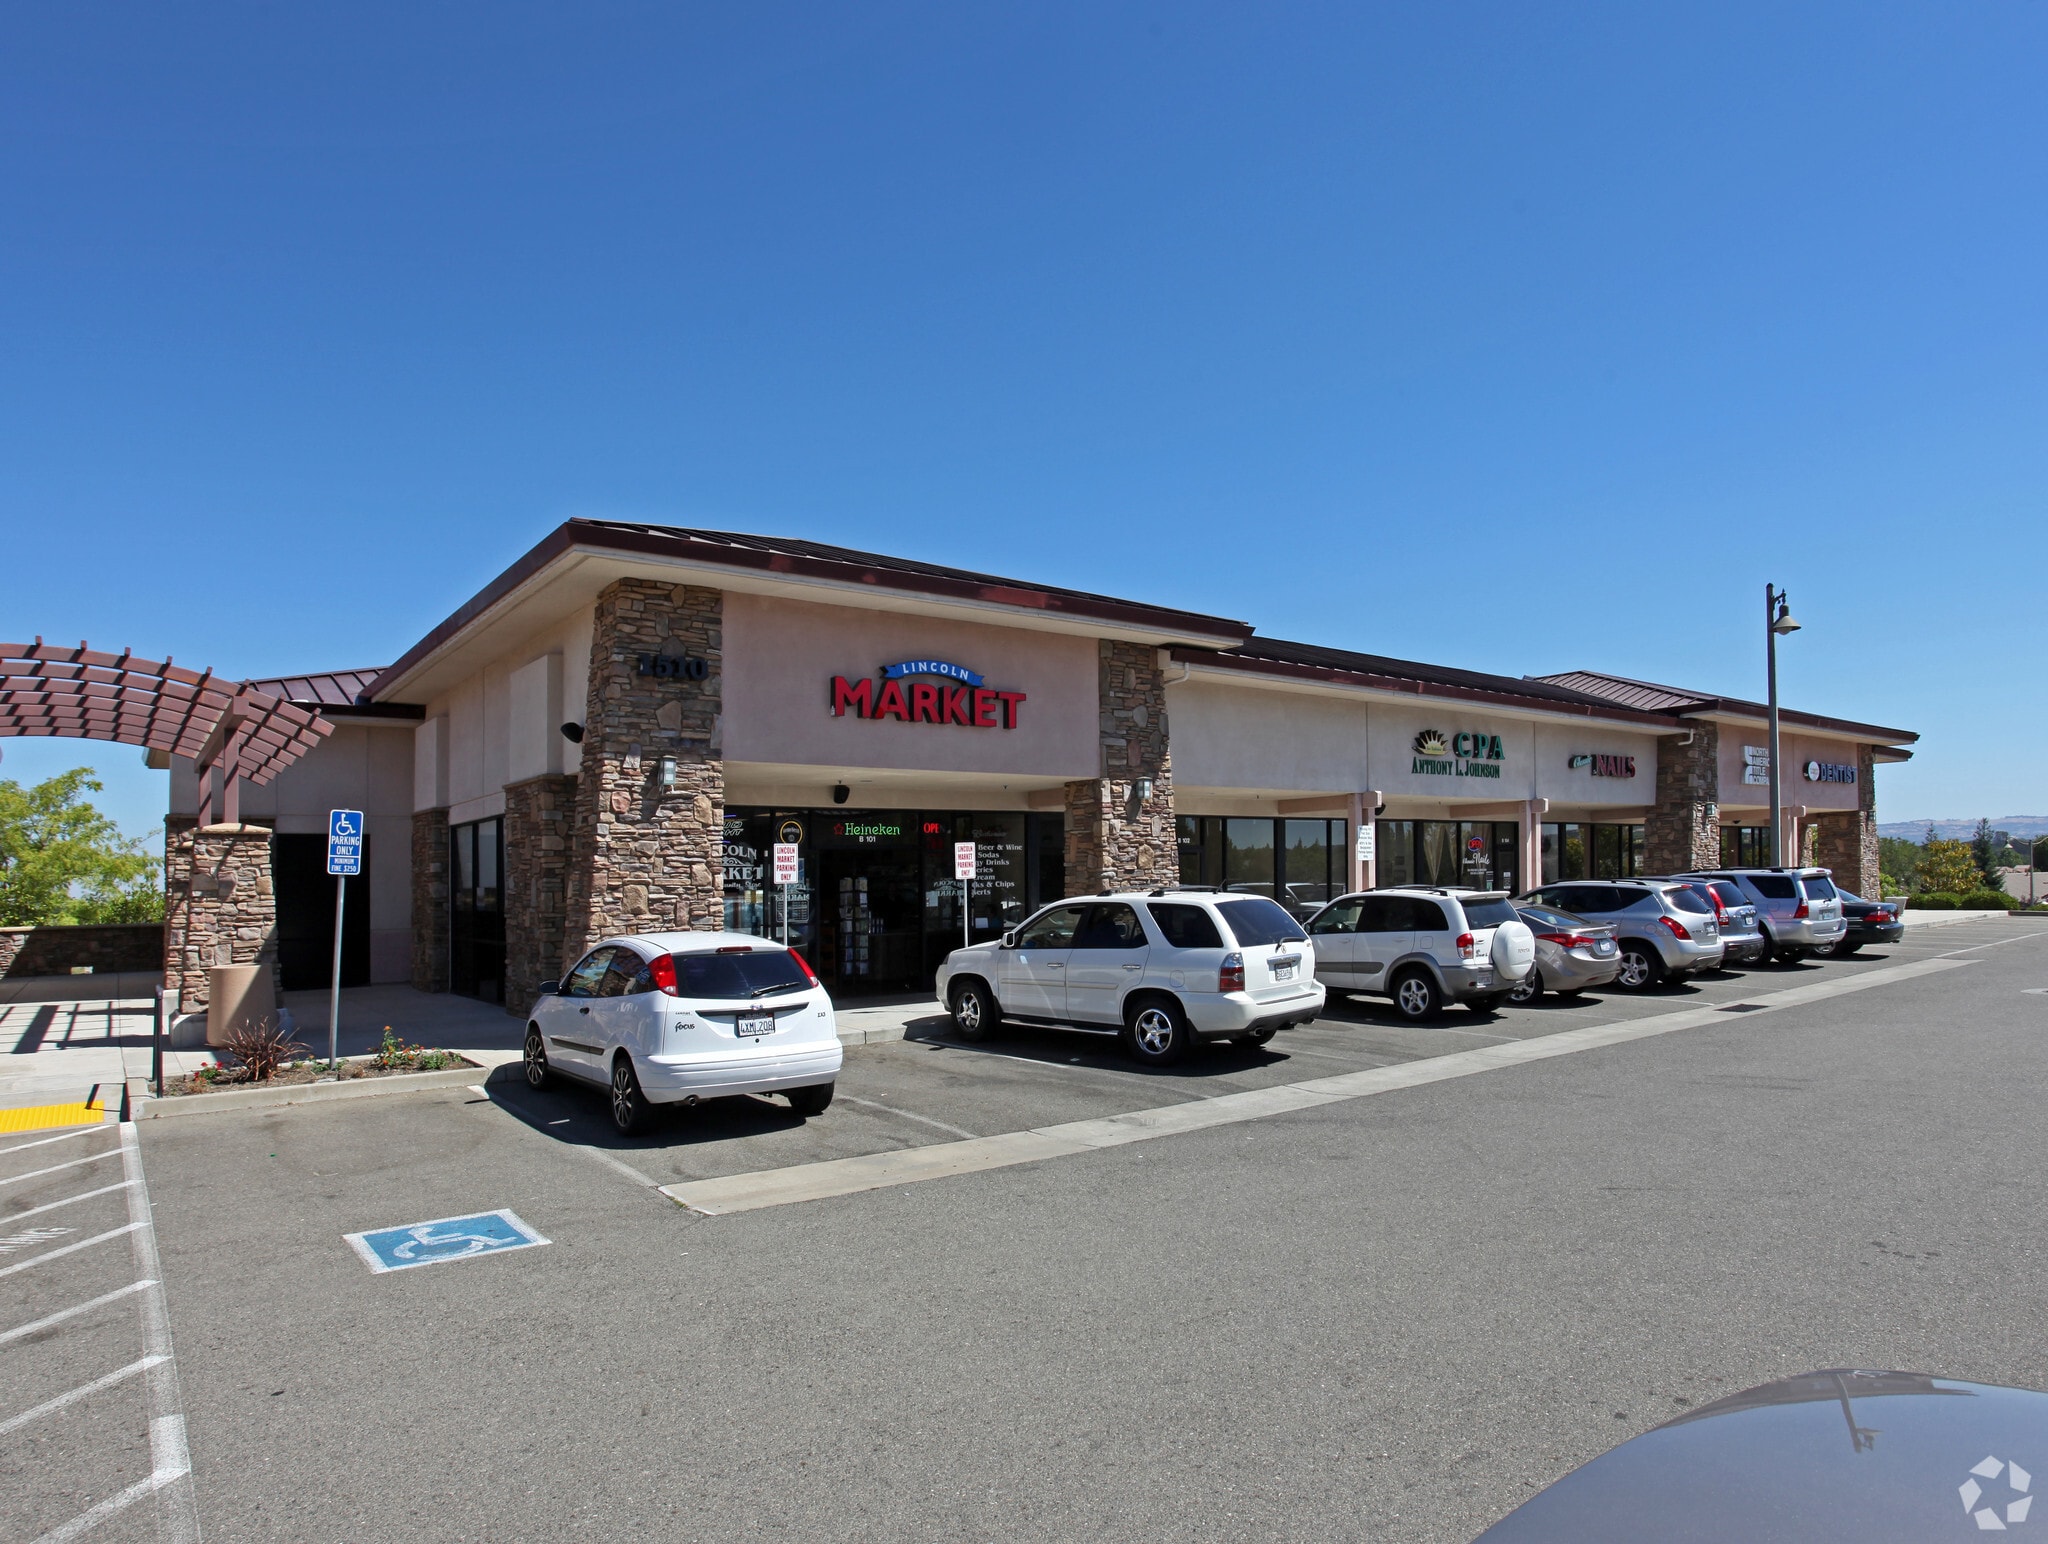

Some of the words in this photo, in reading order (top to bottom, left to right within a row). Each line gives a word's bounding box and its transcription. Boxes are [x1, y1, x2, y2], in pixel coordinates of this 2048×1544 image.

[902, 662, 969, 680] LINCOLN
[831, 675, 1026, 730] MARKET
[1452, 731, 1505, 760] CPA
[1411, 756, 1453, 775] ANTHONY
[1465, 760, 1500, 778] JOHNSON
[1592, 754, 1636, 778] NAILS
[1821, 764, 1857, 784] DENTIST
[844, 823, 900, 835] Heineken
[923, 823, 939, 833] OPE
[331, 836, 360, 846] PARKING
[336, 846, 354, 855] ONLY
[776, 846, 795, 854] LINCOLN
[776, 864, 796, 872] PARKING
[780, 873, 792, 881] ONLY
[994, 880, 1015, 888] Chips
